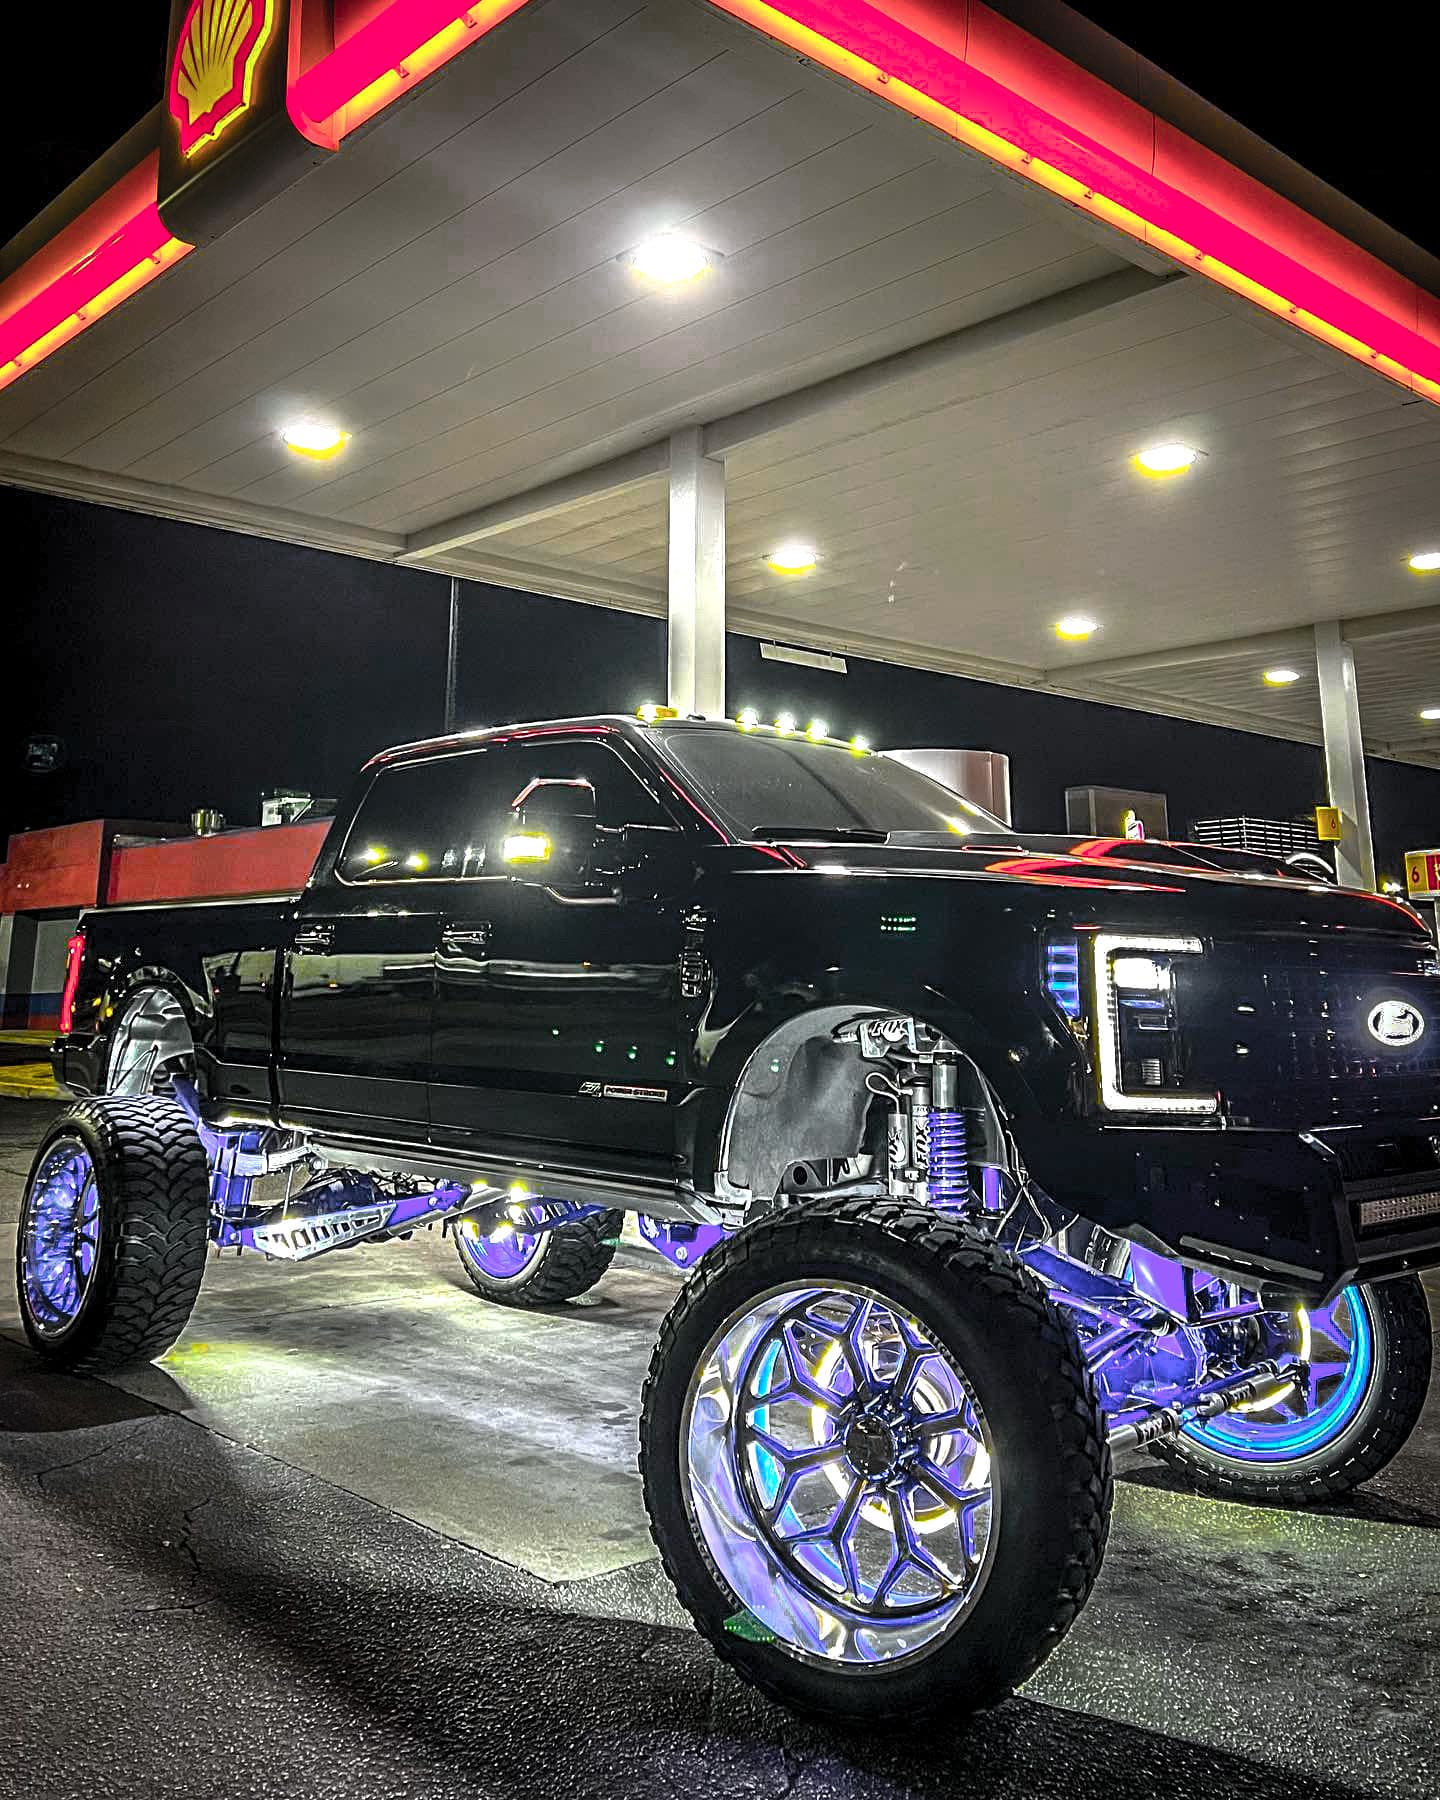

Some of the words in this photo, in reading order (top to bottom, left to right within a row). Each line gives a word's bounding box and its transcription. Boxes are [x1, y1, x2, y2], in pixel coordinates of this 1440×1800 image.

[1331, 818, 1336, 829] 6
[1411, 865, 1420, 884] 6
[872, 1019, 906, 1036] FOX
[915, 1124, 928, 1166] FOX
